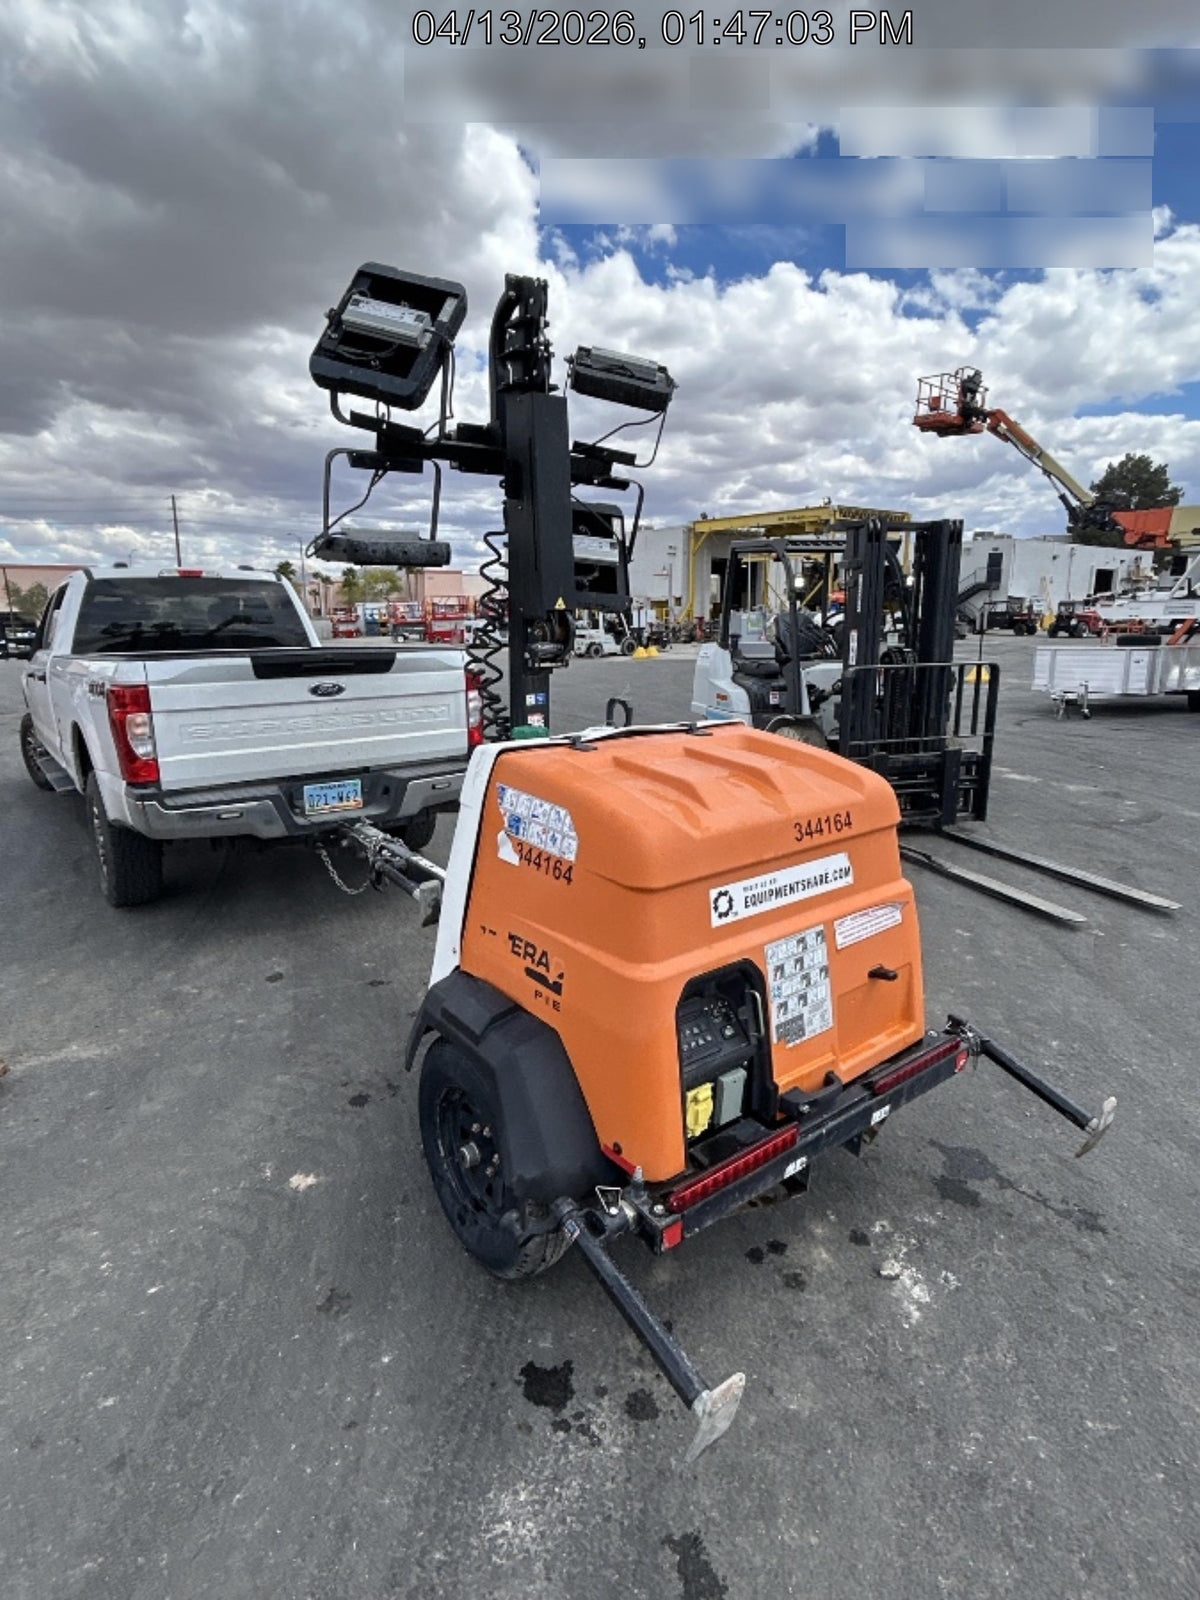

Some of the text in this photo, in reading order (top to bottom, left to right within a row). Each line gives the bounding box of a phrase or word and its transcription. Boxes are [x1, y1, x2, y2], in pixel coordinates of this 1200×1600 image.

[794, 811, 852, 842] 344164
[516, 842, 574, 885] 344164
[743, 865, 851, 909] EQUIPMENTSHARE.COM
